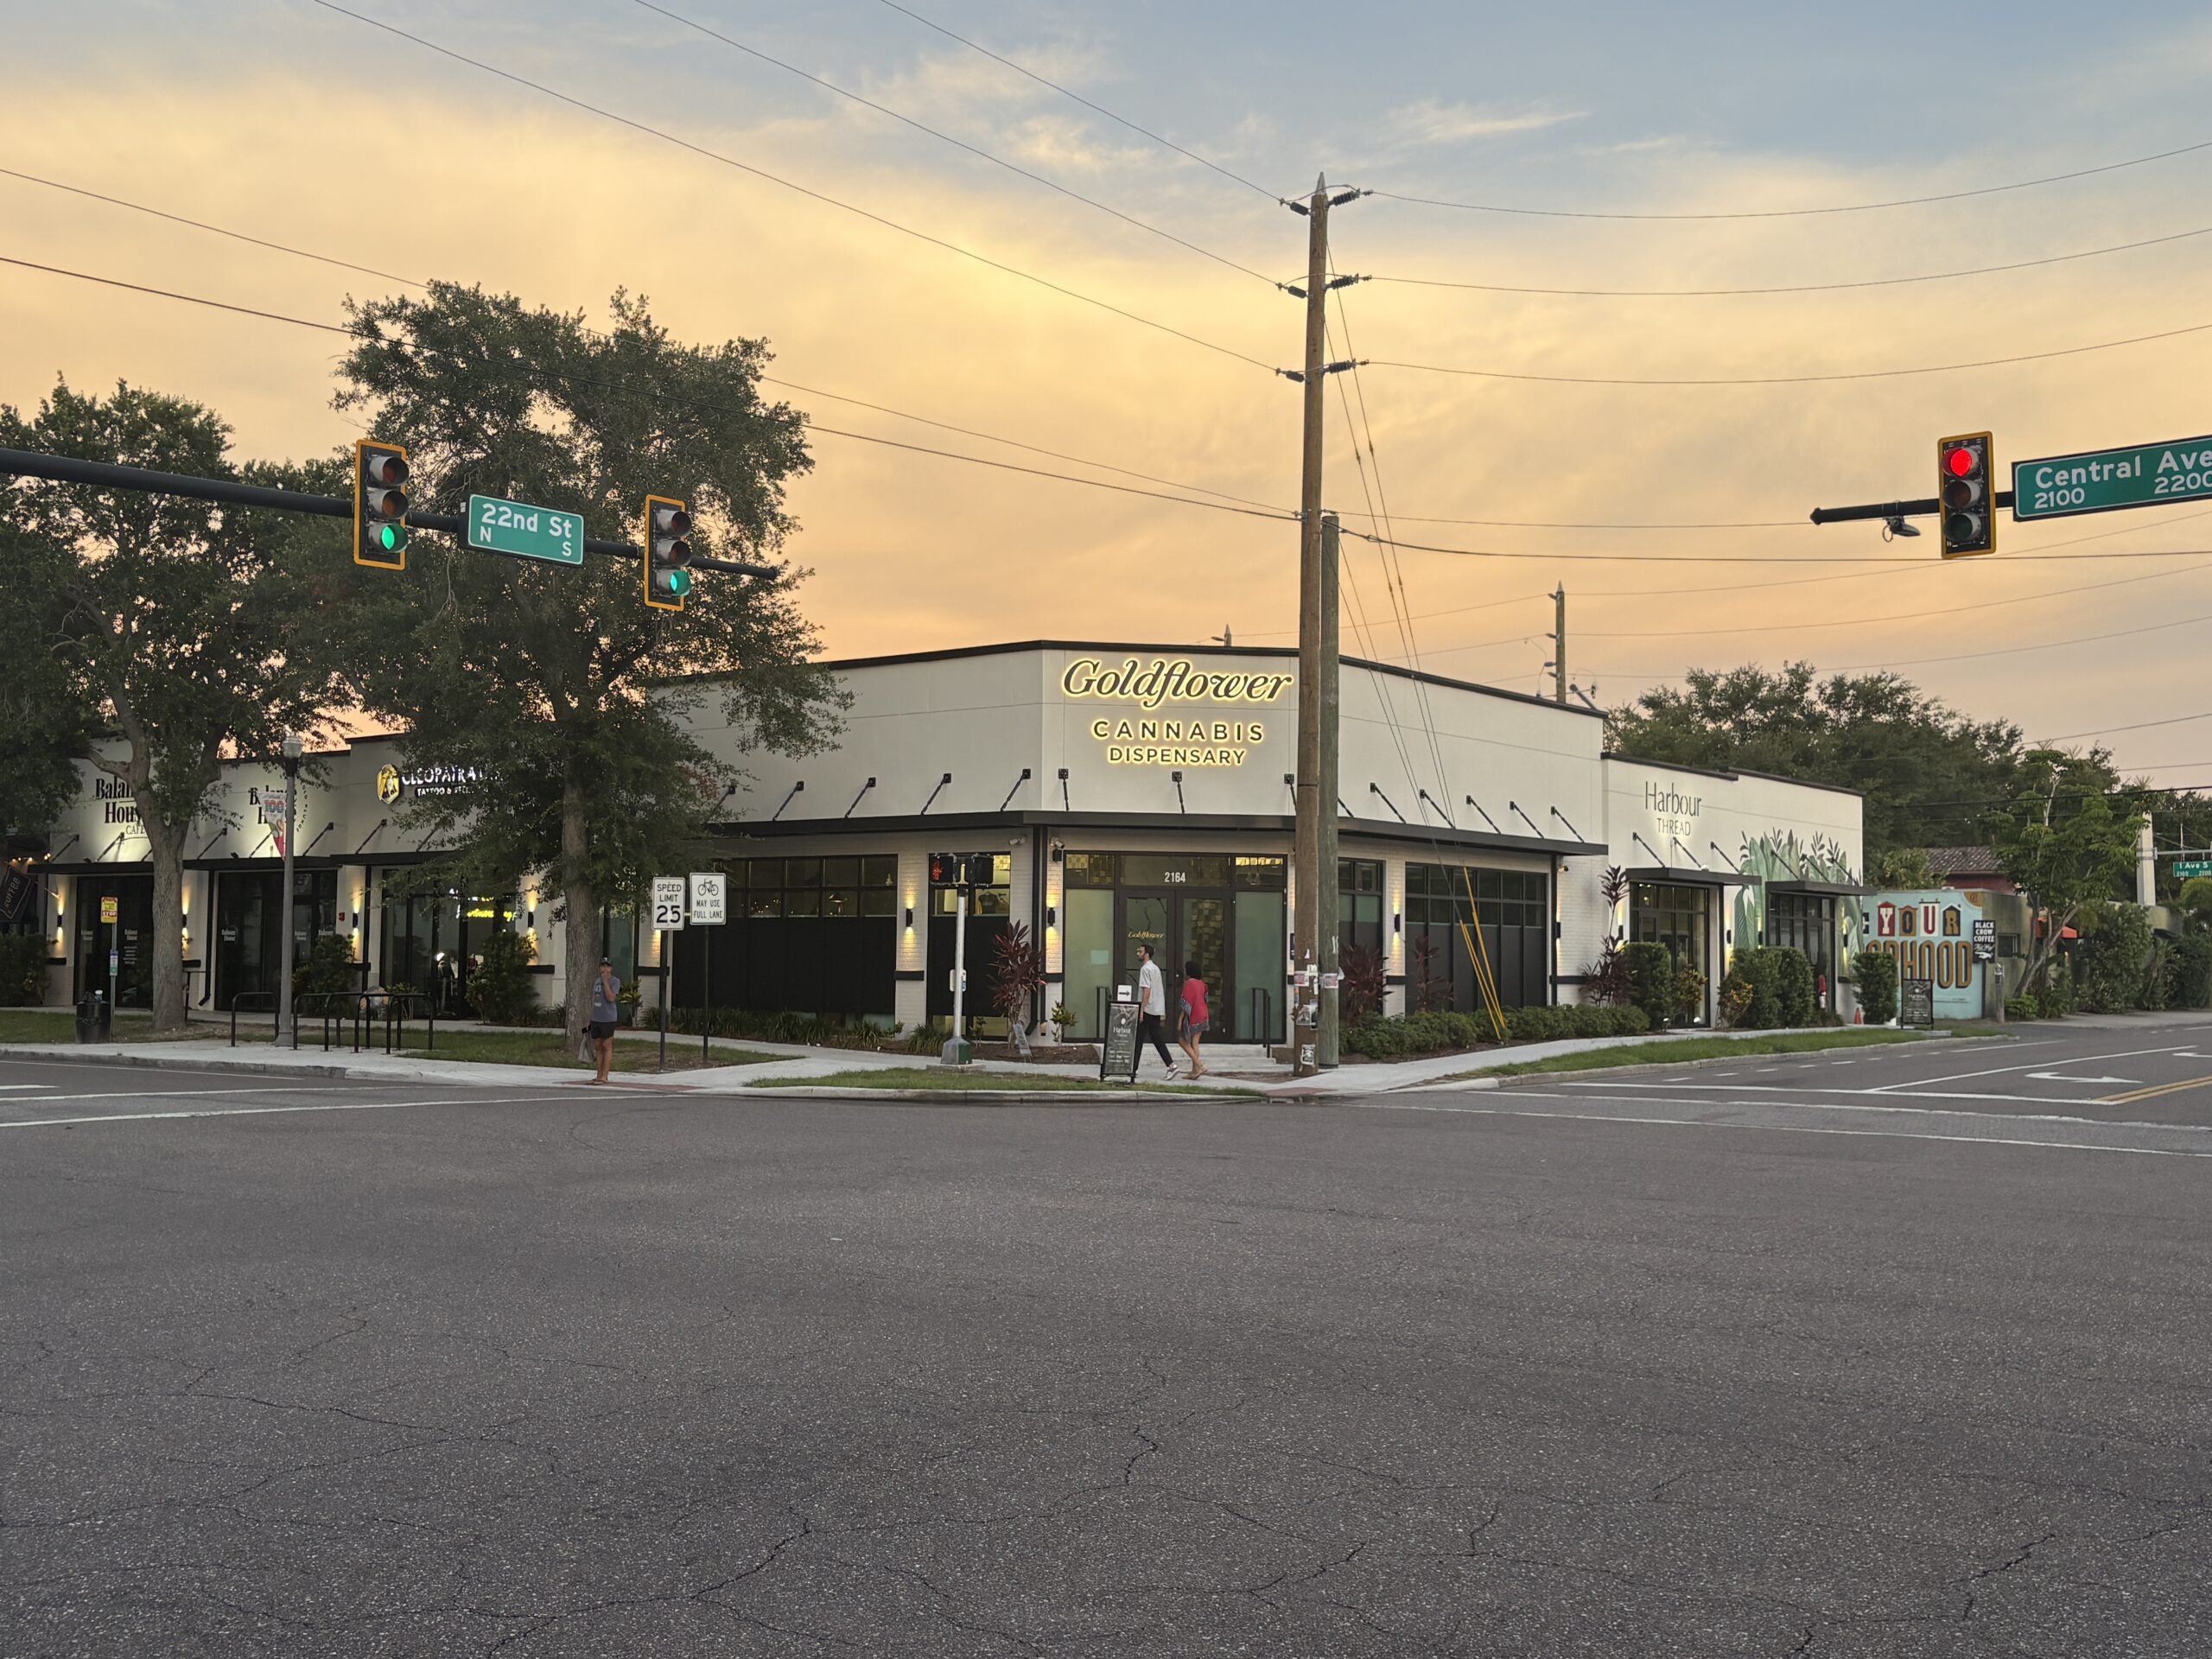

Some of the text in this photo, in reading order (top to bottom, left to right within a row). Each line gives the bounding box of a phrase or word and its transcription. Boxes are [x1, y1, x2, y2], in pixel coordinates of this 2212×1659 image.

[2035, 450, 2212, 489] Central Ave
[2034, 470, 2212, 510] 2100 2200
[481, 503, 572, 538] 22nd St
[480, 525, 572, 556] N S
[1064, 659, 1293, 709] Goldflower
[1093, 721, 1263, 741] CANNABIS
[1109, 747, 1245, 764] DISPENSARY
[1645, 780, 1702, 817] Harbour
[1656, 817, 1691, 836] THREAD
[657, 884, 682, 893] SPEED
[1164, 871, 1186, 883] 2164
[656, 905, 681, 924] 25
[1878, 905, 1961, 936] YOUR
